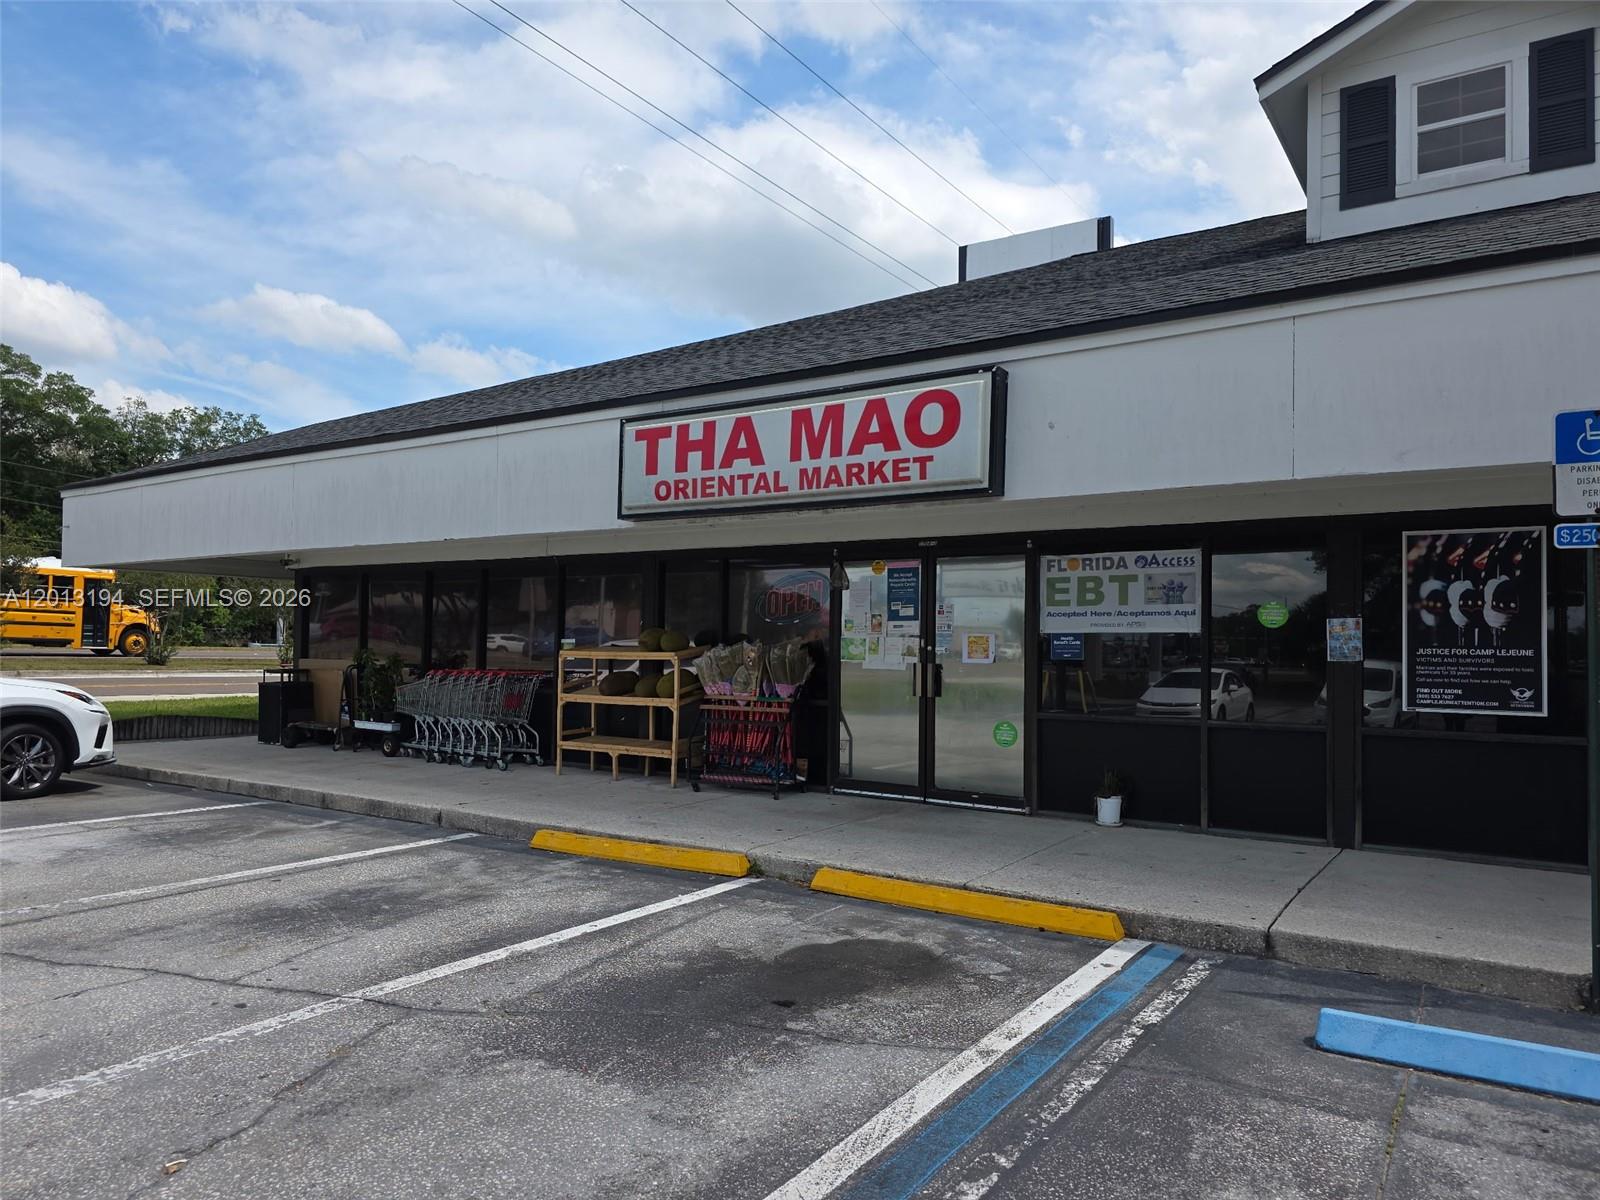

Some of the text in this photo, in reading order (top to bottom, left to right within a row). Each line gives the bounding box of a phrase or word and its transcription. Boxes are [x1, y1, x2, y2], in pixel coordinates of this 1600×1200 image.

[634, 388, 962, 476] THA MAO
[654, 455, 935, 502] ORIENTAL MARKET
[1582, 489, 1600, 497] PER
[1046, 555, 1128, 573] FLORIDA
[765, 579, 824, 618] OPEN
[1045, 574, 1139, 607] EBT
[1046, 610, 1088, 618] Accepted
